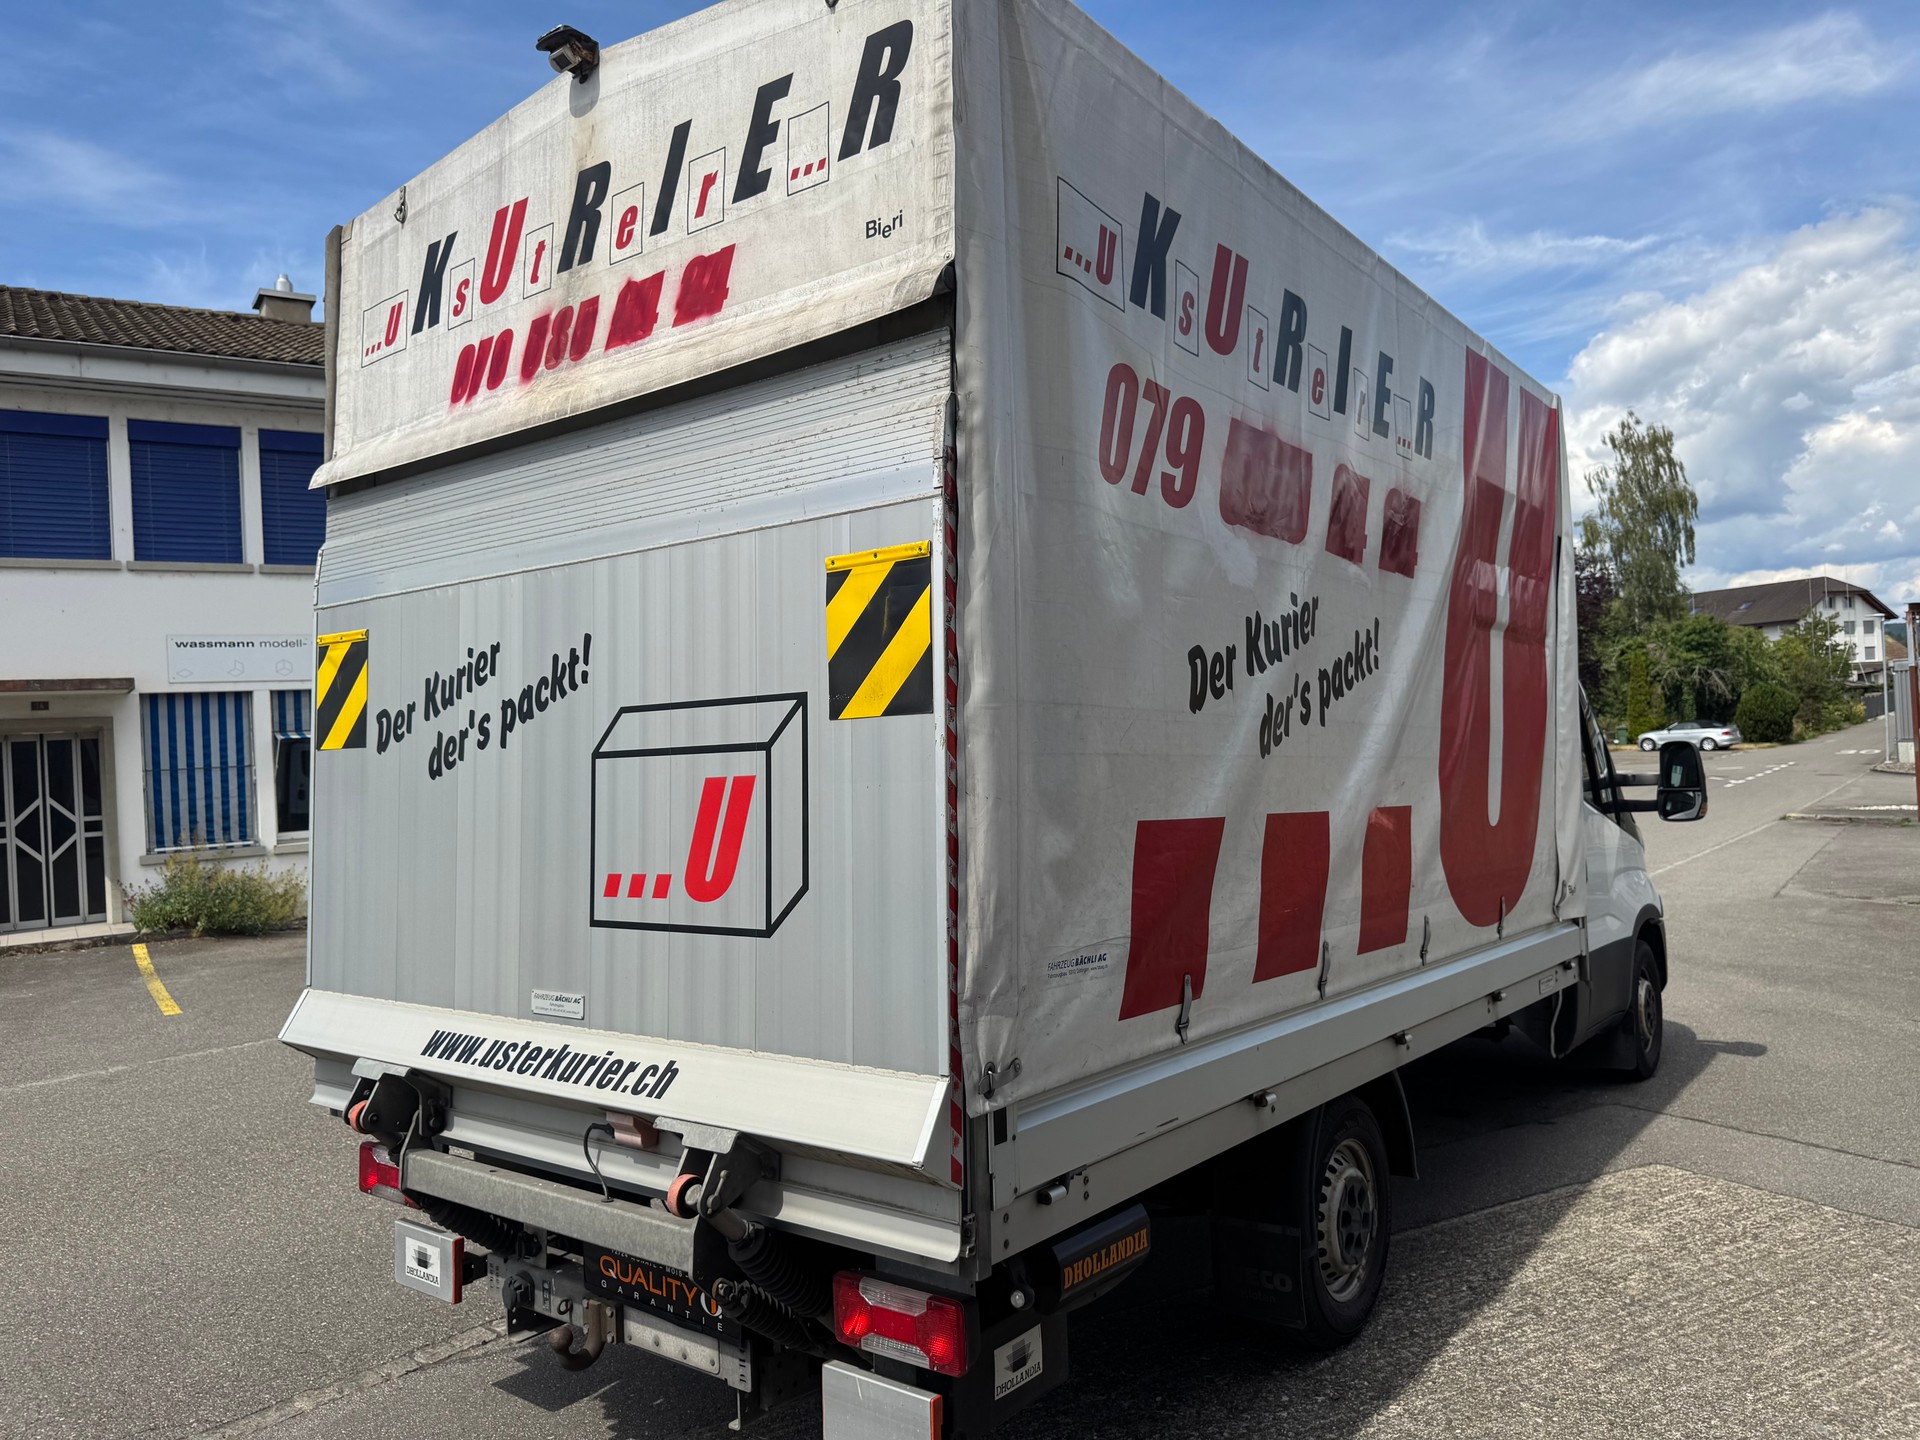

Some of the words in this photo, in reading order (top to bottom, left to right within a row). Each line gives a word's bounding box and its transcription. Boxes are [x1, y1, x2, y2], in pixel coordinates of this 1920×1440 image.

[865, 209, 903, 239] Bieri
[1099, 362, 1206, 509] 079
[174, 640, 255, 648] wassmann
[1187, 643, 1237, 715] Der
[1245, 591, 1319, 677] Kurier
[376, 701, 416, 756] Der
[424, 641, 501, 722] Kurier
[428, 709, 491, 781] der's
[500, 632, 592, 750] packt!
[1259, 672, 1311, 760] der's
[1318, 616, 1380, 728] packt!
[420, 1029, 680, 1100] www.usterkurier.ch
[406, 1265, 440, 1286] DHOLLANDIA
[599, 1254, 698, 1307] QUALITY
[1063, 1227, 1148, 1290] DHOLLANDIA
[601, 1279, 724, 1332] GARANTIE
[995, 1360, 1042, 1397] DHOLLANDIA
